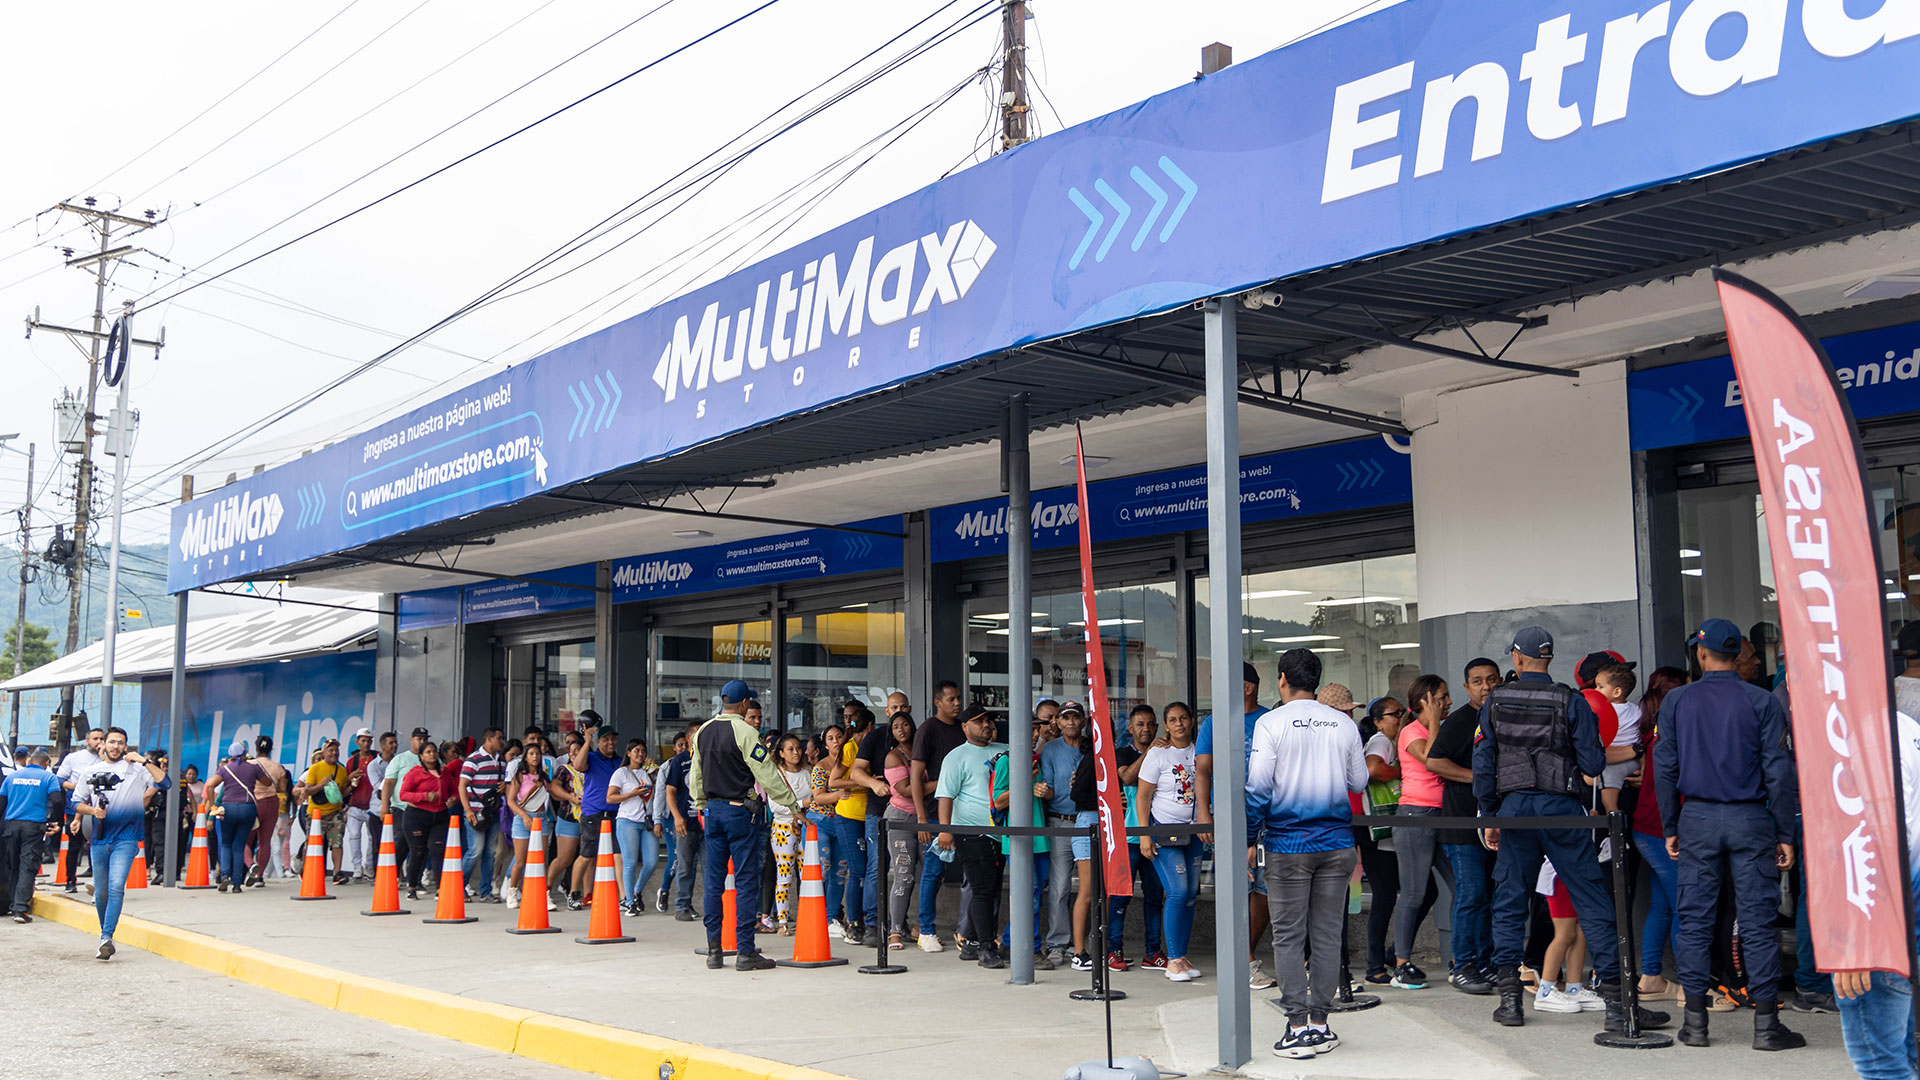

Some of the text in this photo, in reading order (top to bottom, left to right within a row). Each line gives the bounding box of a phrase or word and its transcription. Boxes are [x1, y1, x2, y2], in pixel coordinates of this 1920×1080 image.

[664, 220, 966, 404] MultiMax
[363, 384, 511, 463] ¡Ingresa a nuestra página web!
[360, 435, 531, 511] www.multimaxstore.com
[1135, 482, 1169, 496] ¡Ingresa
[1178, 476, 1208, 489] nuestr
[1248, 465, 1272, 476] web!
[184, 491, 275, 562] MultiMax
[616, 560, 686, 587] MultiMax
[726, 555, 818, 575] www.multimaxstore.com
[719, 642, 771, 657] MultiMa
[1313, 720, 1338, 728] Group
